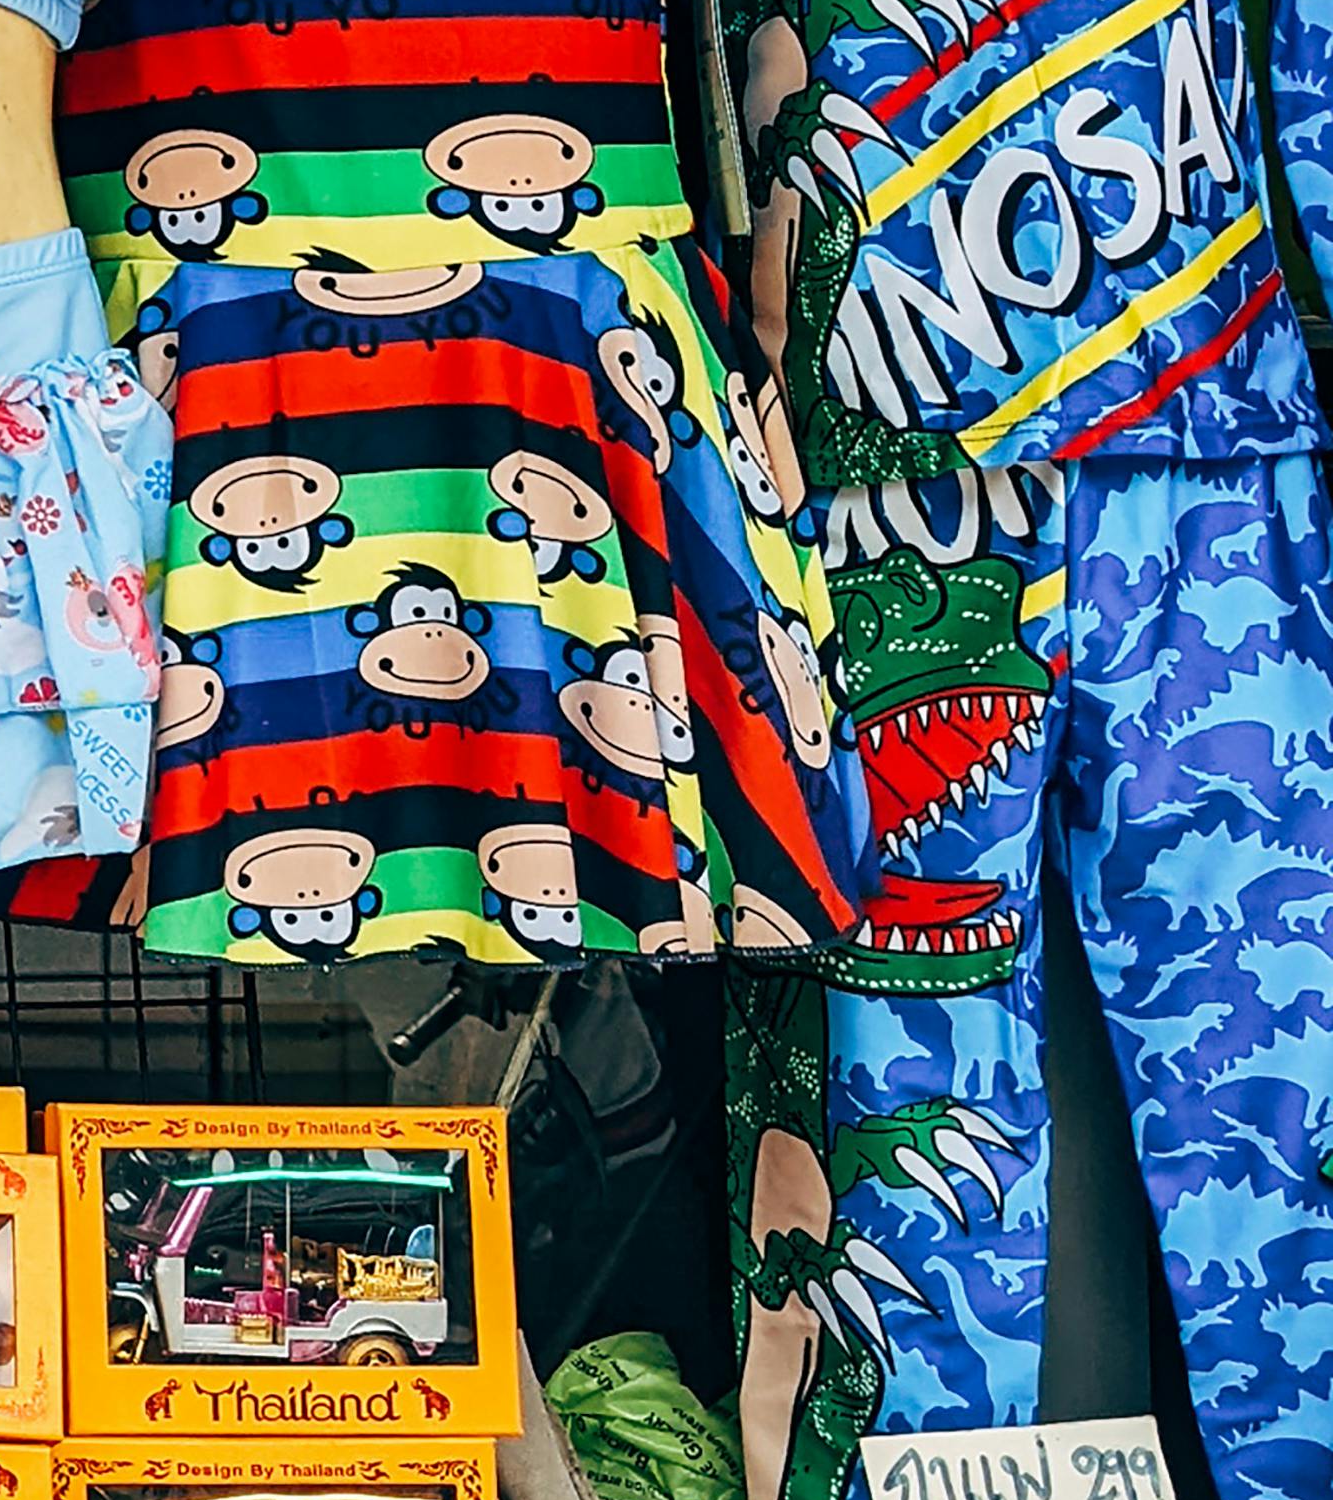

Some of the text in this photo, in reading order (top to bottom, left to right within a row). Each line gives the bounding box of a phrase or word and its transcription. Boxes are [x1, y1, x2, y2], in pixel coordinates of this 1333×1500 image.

[70, 720, 143, 786] SWEET
[194, 1120, 372, 1138] Design By Thailand
[193, 1380, 401, 1422] Thailand
[177, 1462, 356, 1480] Design By Thailand
